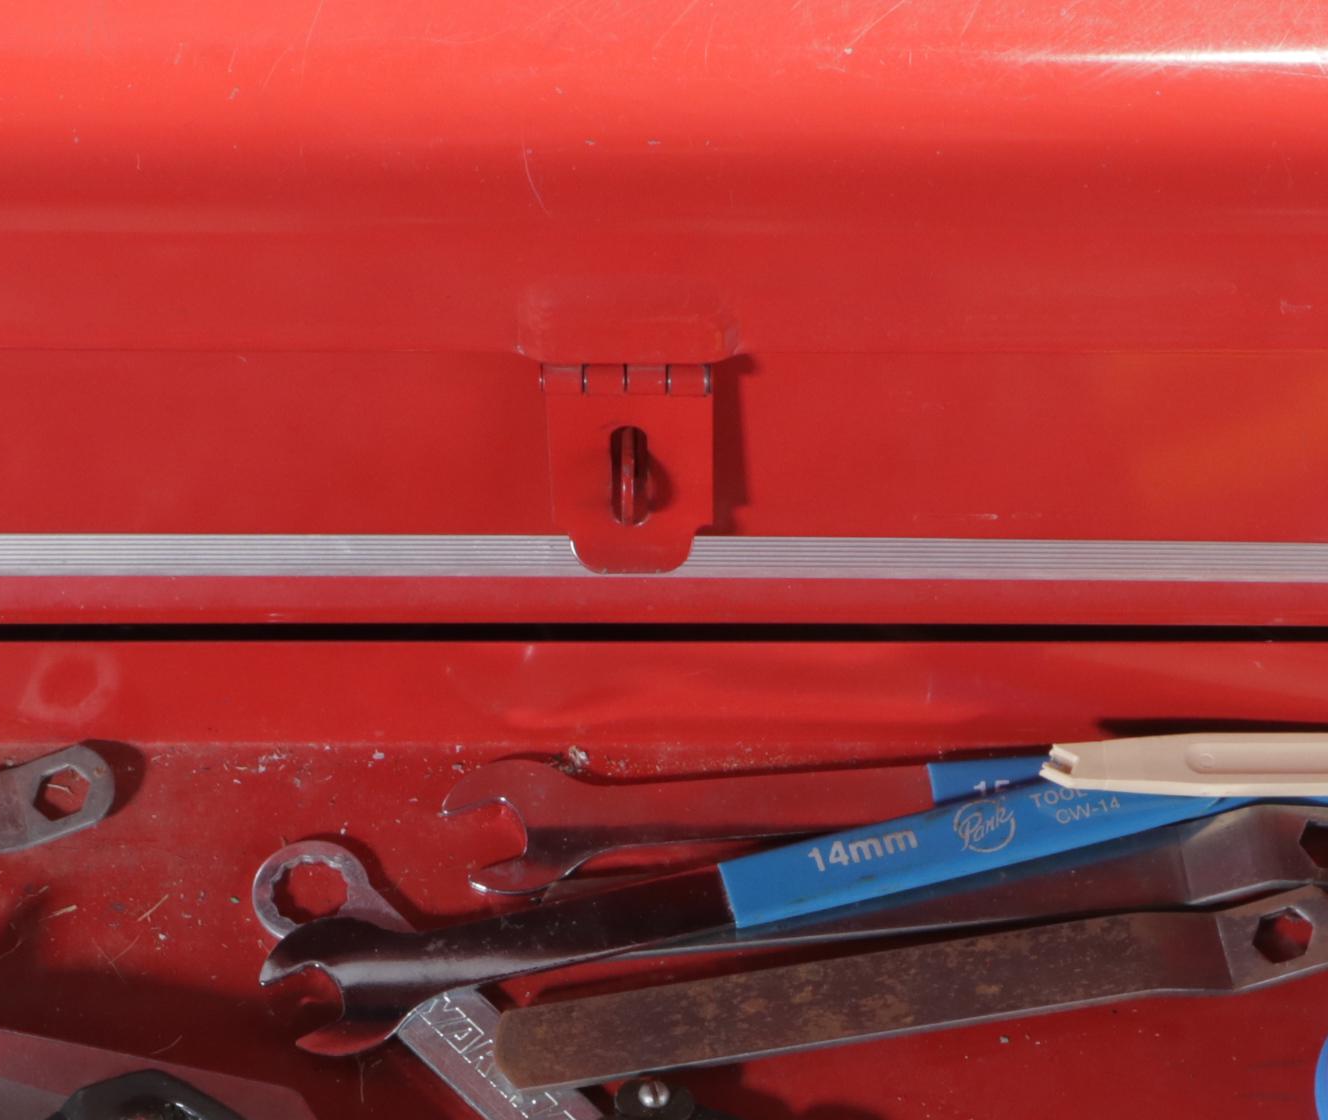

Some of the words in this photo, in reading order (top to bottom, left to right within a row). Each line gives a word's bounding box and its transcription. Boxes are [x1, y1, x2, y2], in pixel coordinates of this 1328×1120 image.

[958, 798, 1014, 851] Park
[1055, 797, 1120, 824] CW-14
[808, 828, 919, 872] 14mm
